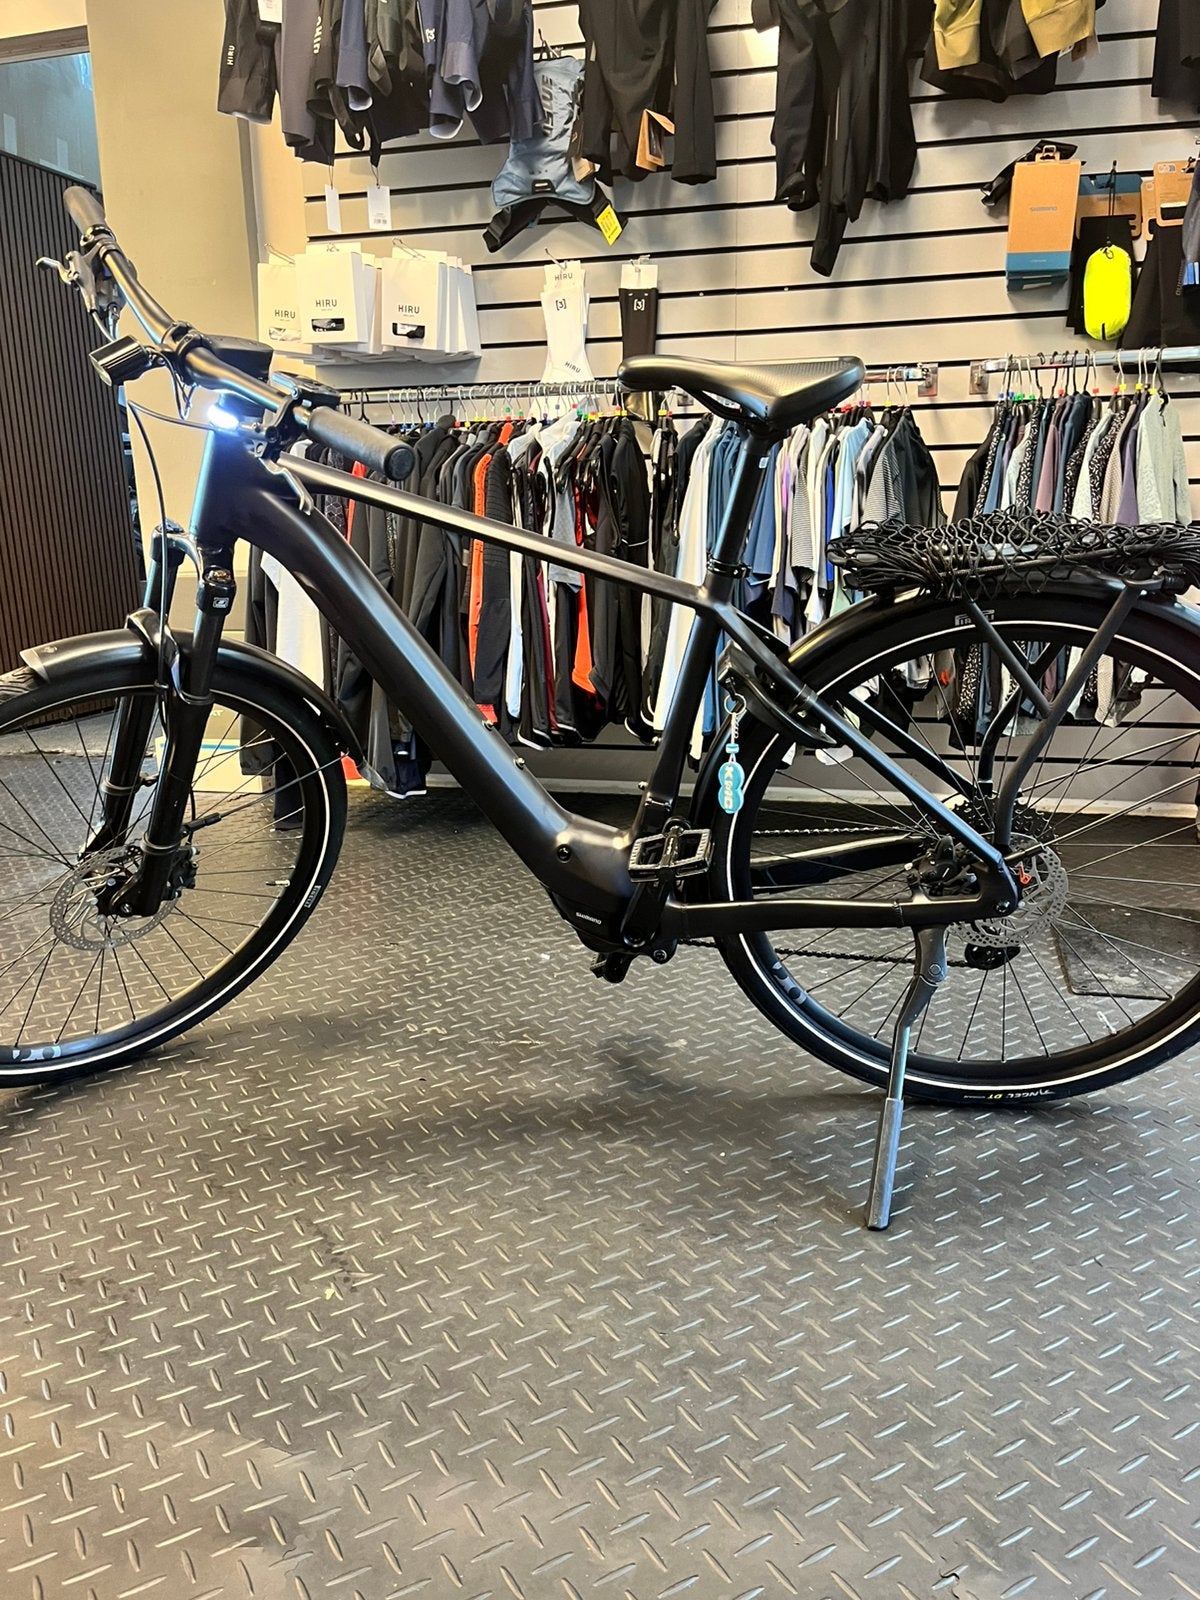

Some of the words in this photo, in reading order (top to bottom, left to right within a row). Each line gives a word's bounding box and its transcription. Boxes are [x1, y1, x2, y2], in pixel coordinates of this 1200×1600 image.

[226, 45, 236, 66] HIRU
[554, 272, 574, 281] HIRU
[315, 298, 338, 307] HIRU
[274, 309, 296, 319] HIRU
[398, 304, 421, 314] HIRU
[564, 361, 582, 374] HIRU
